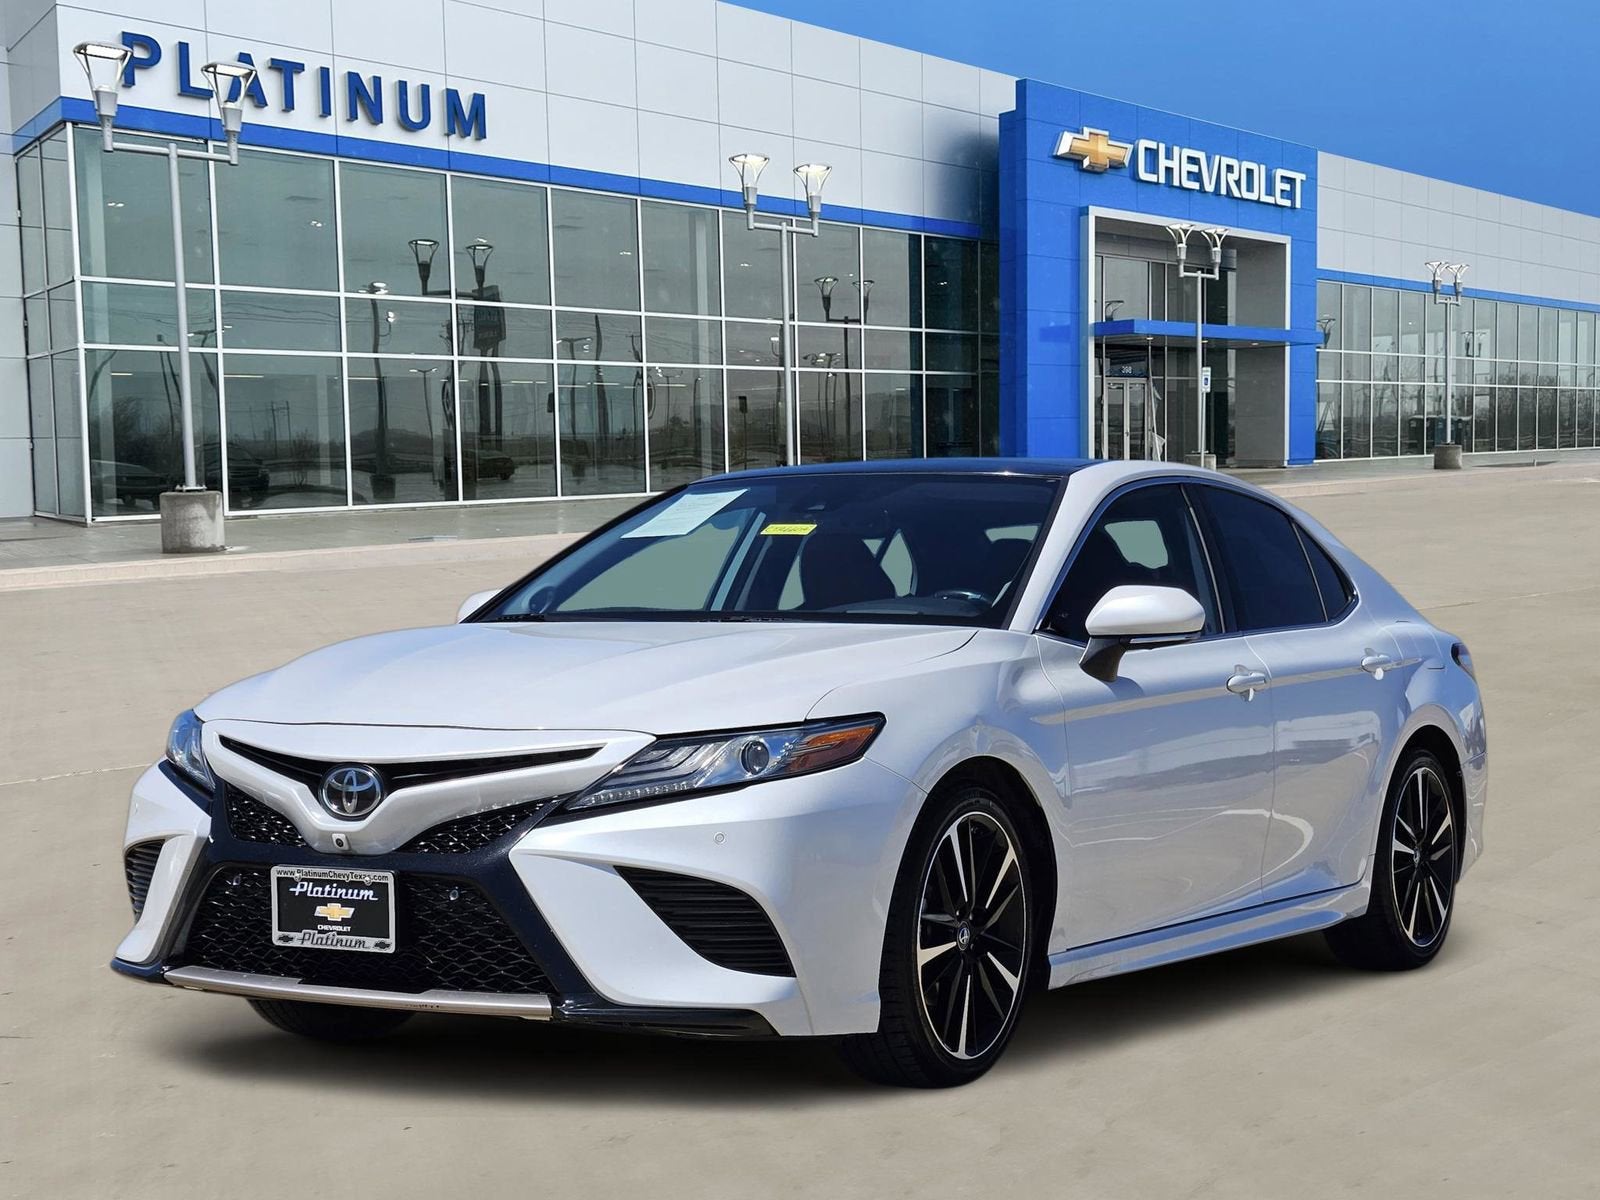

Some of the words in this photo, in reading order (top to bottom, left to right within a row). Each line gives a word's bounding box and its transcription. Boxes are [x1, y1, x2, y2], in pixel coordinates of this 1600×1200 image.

[120, 31, 487, 140] PLATINUM
[1136, 139, 1306, 209] CHEVROLET
[276, 868, 389, 882] wwwPlatinumChevyTexas.com
[289, 882, 378, 901] Platinum
[317, 924, 352, 932] CHEVROLET
[298, 931, 369, 949] Platinum
